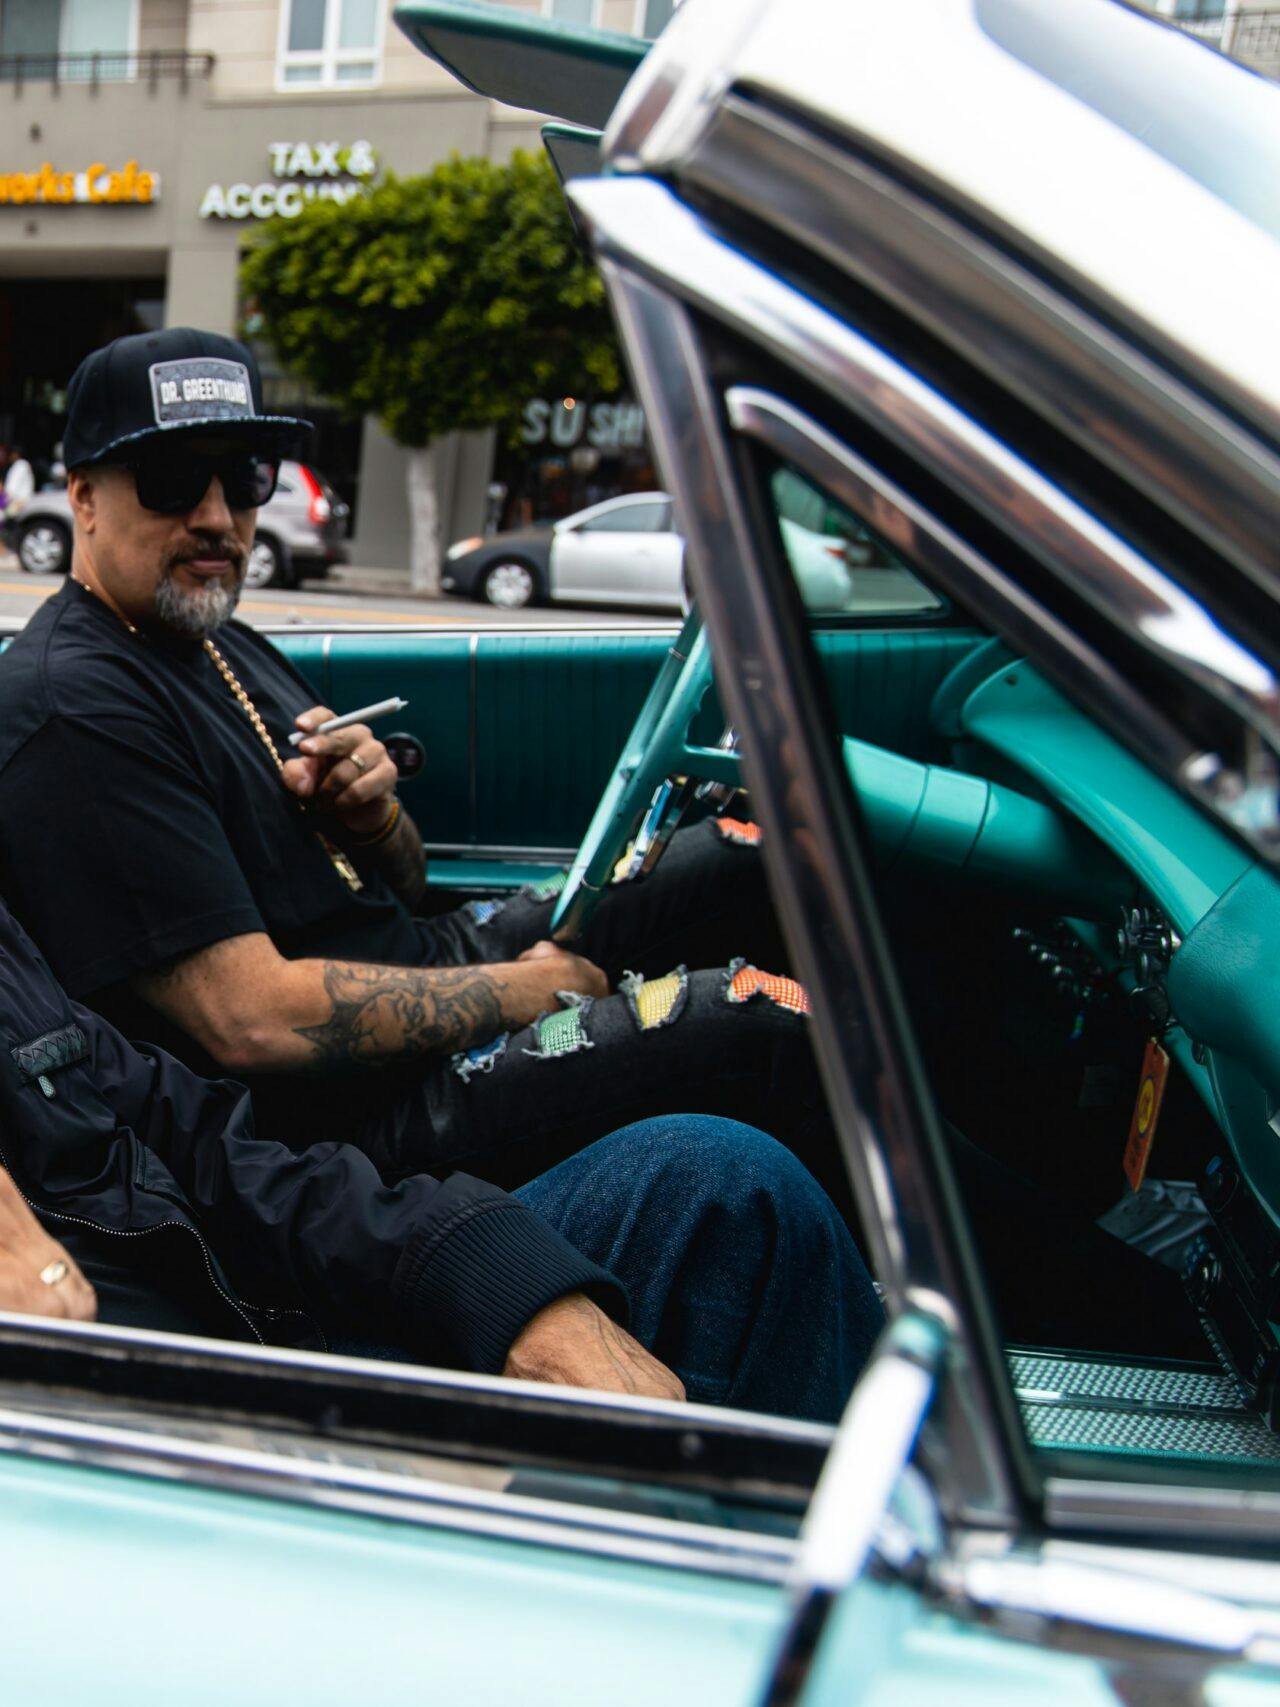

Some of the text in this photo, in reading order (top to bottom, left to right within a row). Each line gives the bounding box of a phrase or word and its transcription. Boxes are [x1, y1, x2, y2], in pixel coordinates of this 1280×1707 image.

[268, 139, 376, 177] TAX &
[160, 377, 247, 405] DR. GREENTHUMB
